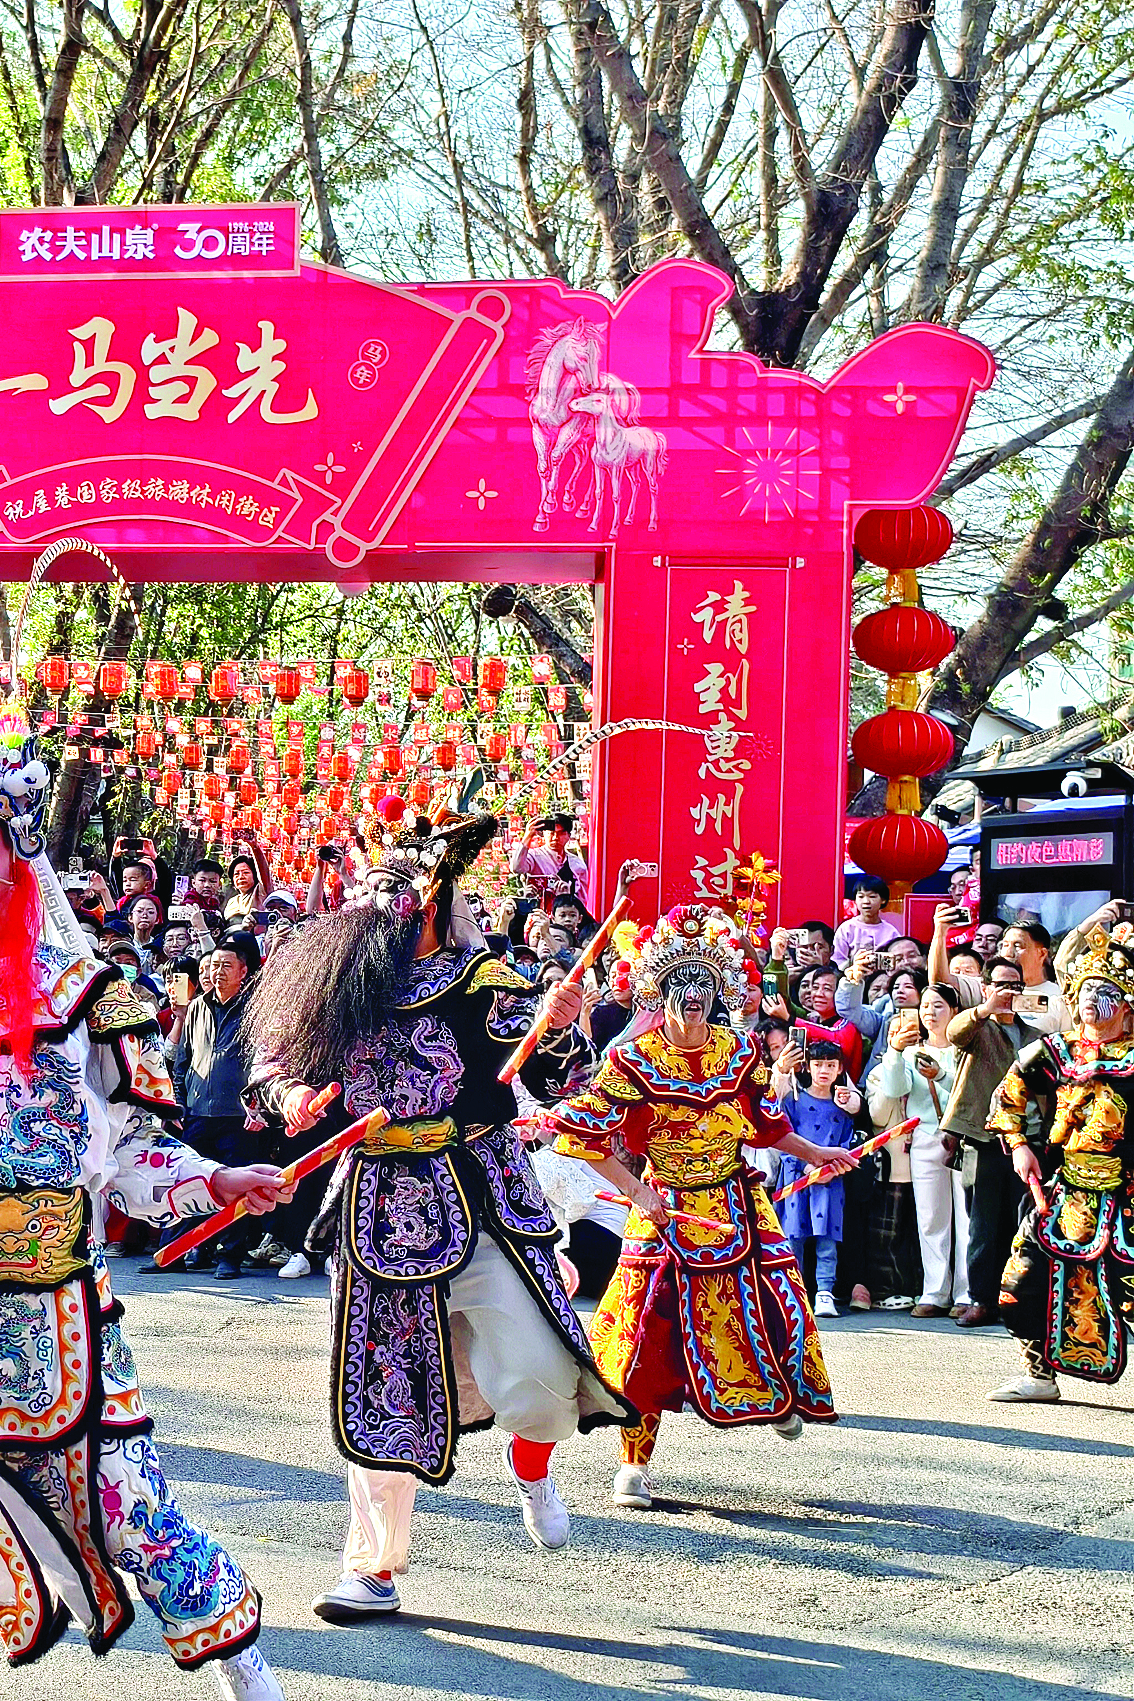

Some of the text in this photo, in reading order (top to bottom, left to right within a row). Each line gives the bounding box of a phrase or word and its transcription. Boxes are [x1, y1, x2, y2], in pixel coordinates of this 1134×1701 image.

[18, 225, 156, 262] 农夫山泉
[228, 222, 275, 232] 1996-2026
[4, 476, 281, 528] 祝屋巷国家级旅游休闲街区
